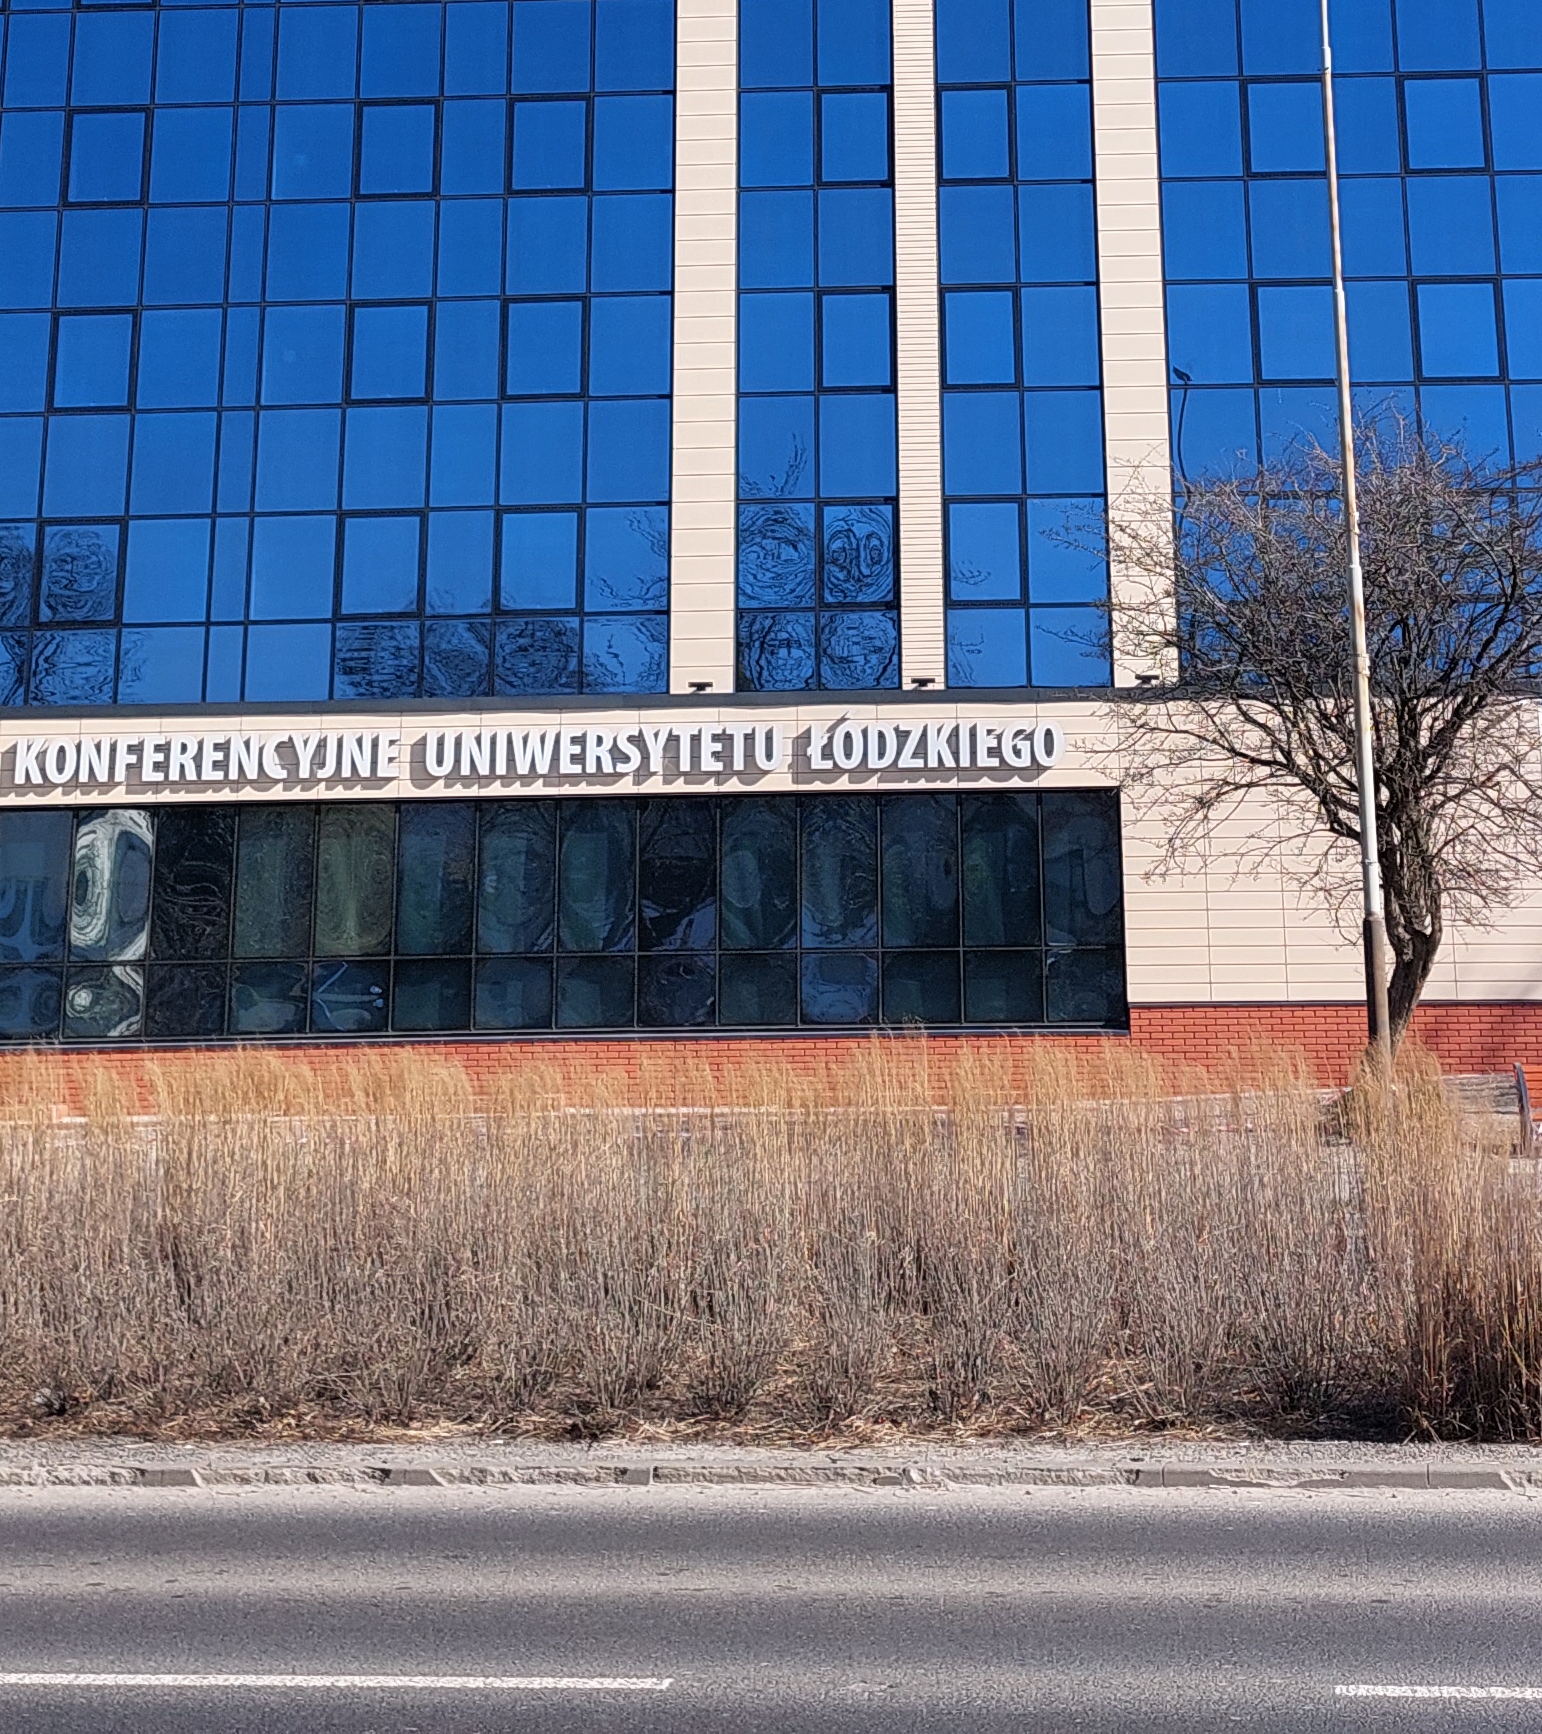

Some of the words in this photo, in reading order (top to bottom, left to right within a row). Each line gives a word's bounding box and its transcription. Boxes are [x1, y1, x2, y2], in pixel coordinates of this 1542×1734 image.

[14, 731, 401, 785] KONFERENCYJNE
[424, 724, 784, 777] UNIWERSYTETU
[806, 709, 1065, 770] ŁÓDZKIEGO
